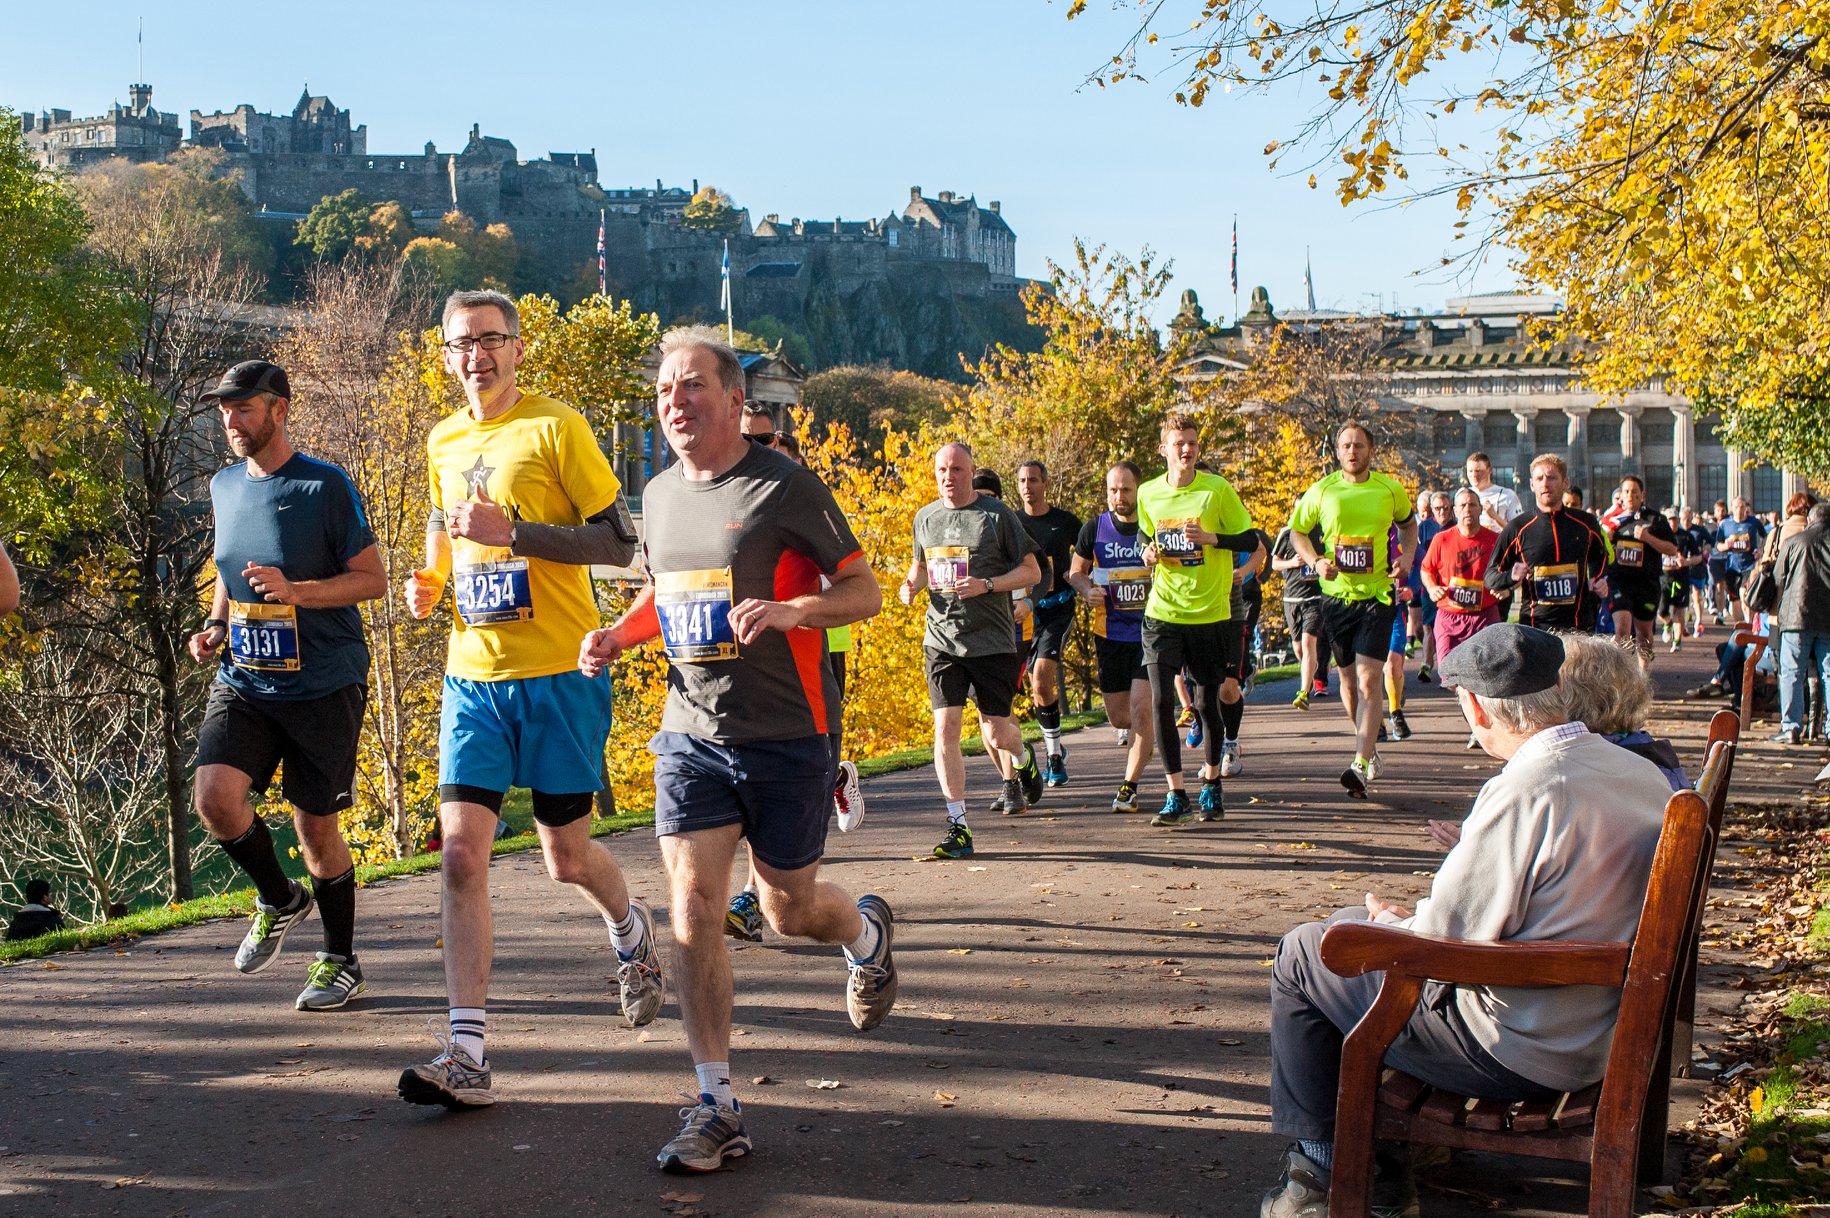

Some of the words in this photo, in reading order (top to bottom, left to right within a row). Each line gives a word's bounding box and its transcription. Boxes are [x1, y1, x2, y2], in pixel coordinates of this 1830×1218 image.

[1104, 541, 1142, 558] Strok
[1340, 550, 1367, 567] 4013
[464, 573, 516, 610] 3254
[1117, 584, 1146, 601] 4023
[1453, 588, 1477, 605] 4064
[1544, 579, 1572, 597] 3118
[665, 603, 713, 643] 3341
[241, 627, 281, 657] 3131
